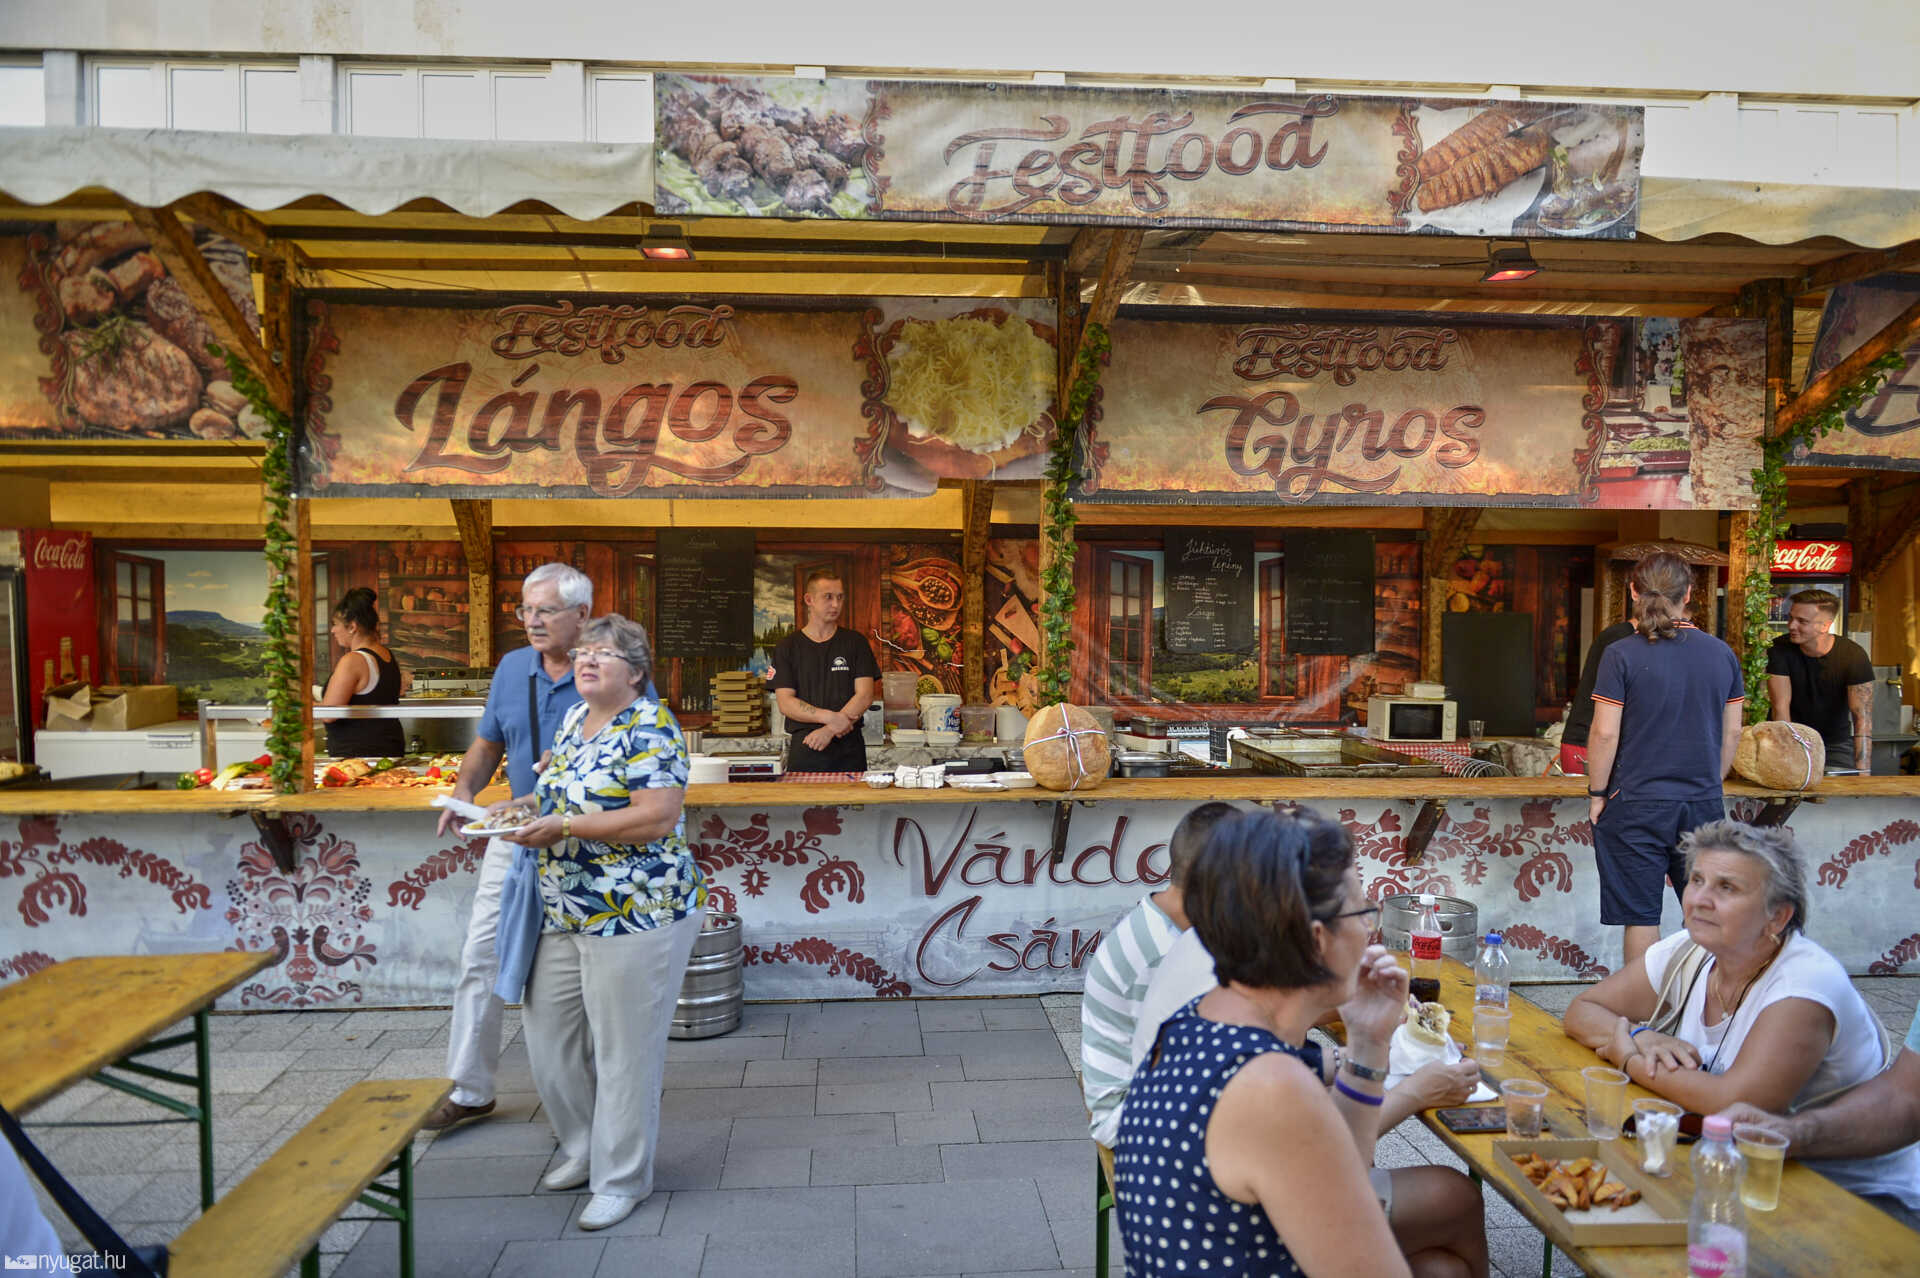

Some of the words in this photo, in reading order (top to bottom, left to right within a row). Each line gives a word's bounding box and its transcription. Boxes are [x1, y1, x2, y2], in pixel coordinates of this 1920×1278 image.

[944, 95, 1339, 220] Festfood
[491, 300, 735, 365] Festfood
[1232, 324, 1458, 386] Festfood
[395, 361, 799, 497] Lángos
[1196, 390, 1487, 504] Gyros
[894, 806, 1173, 897] Vándo
